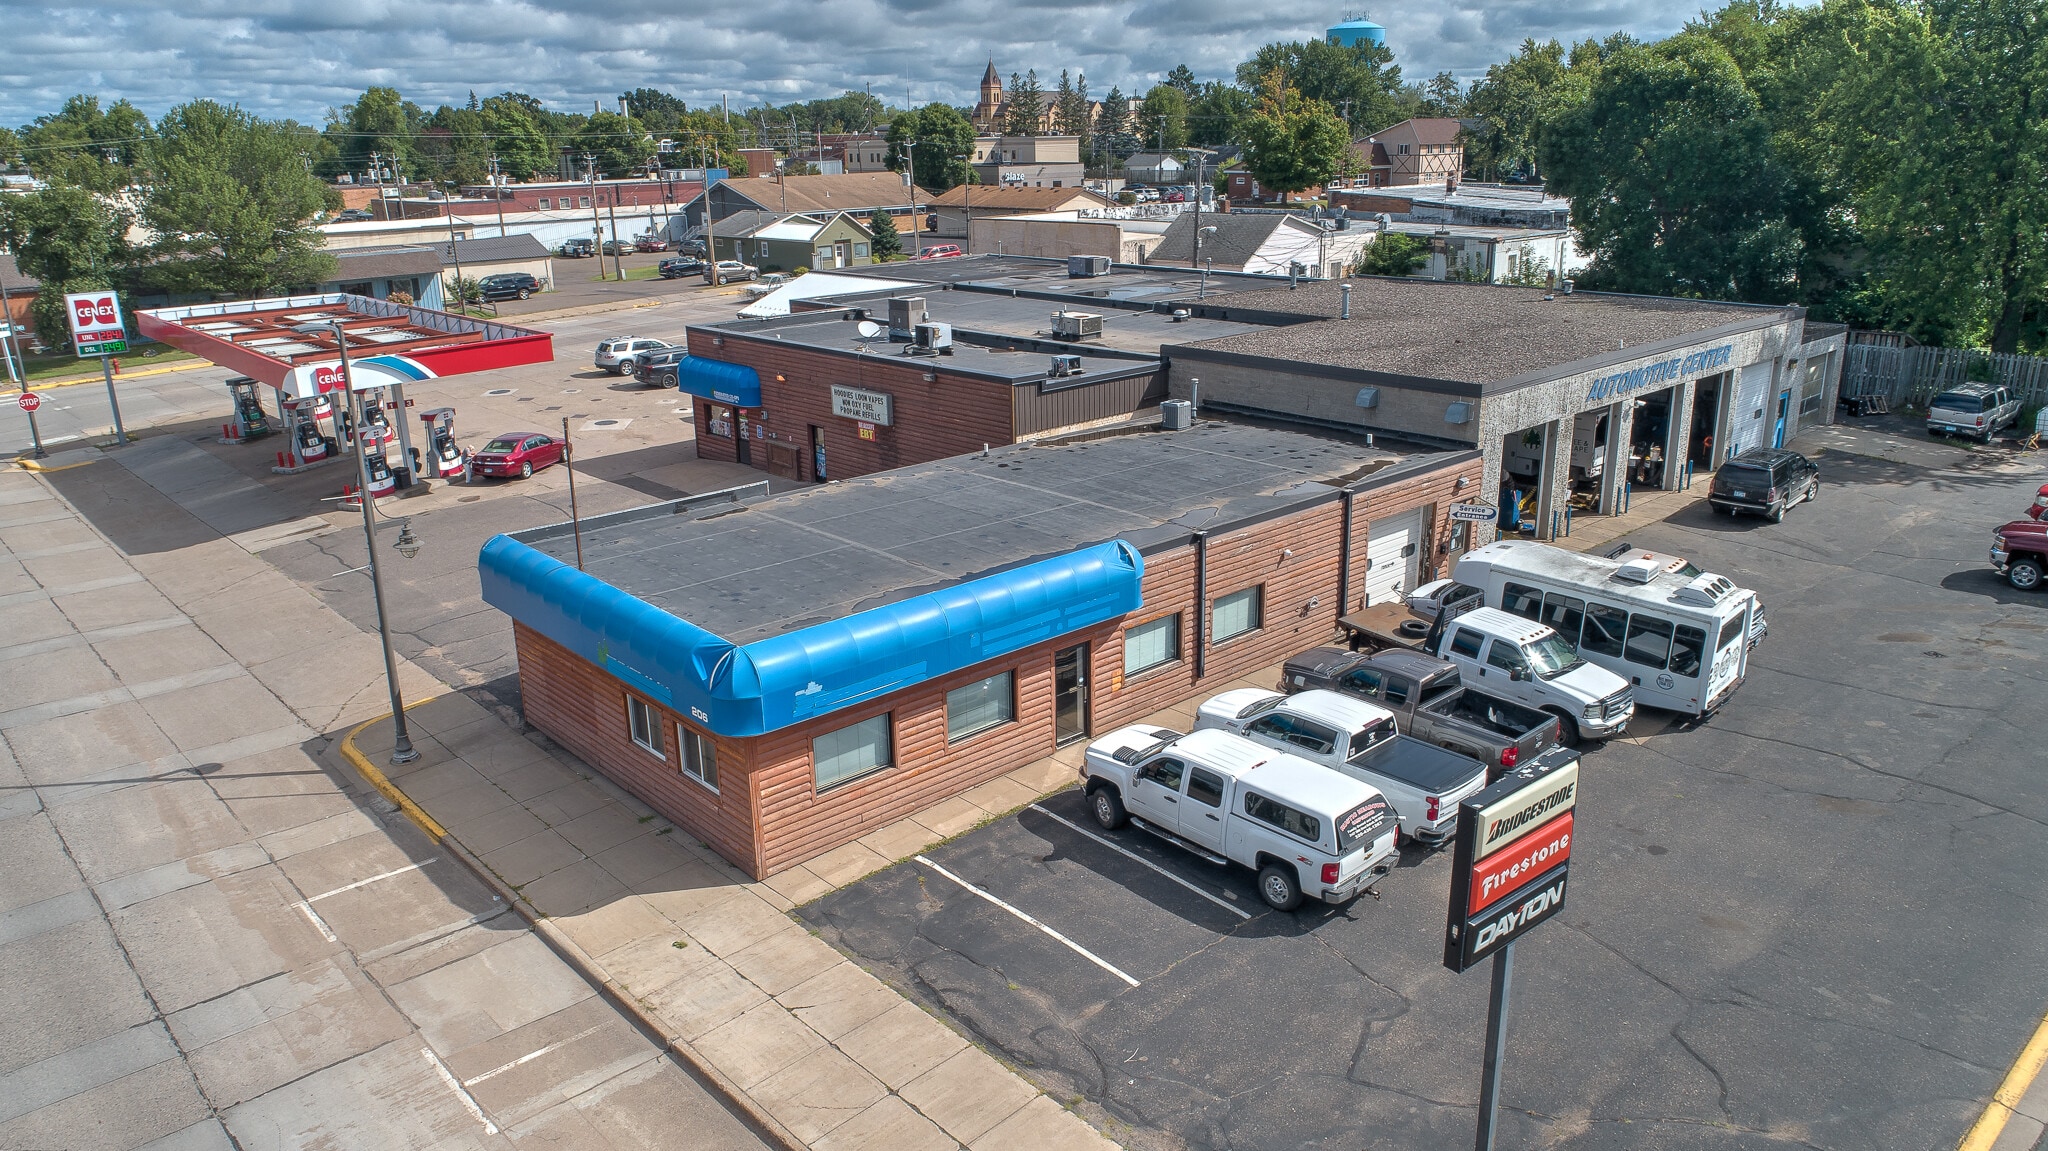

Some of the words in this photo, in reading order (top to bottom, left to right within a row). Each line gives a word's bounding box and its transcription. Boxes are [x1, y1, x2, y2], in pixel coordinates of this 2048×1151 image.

[77, 306, 114, 317] CENEX
[319, 372, 346, 384] CENE
[1585, 358, 1681, 402] AUTOMOTIVE
[1681, 344, 1732, 376] CENTER
[20, 398, 39, 407] STOP
[834, 388, 853, 399] HOODIES
[868, 396, 884, 405] VAPES
[852, 401, 861, 409] OXY
[862, 403, 874, 411] FUEL
[840, 406, 861, 417] PROPANE
[862, 412, 880, 420] REFILLS
[860, 429, 873, 440] EBT
[1459, 505, 1486, 513] Service
[1457, 512, 1488, 520] Entrance
[691, 706, 708, 723] 206
[1486, 781, 1575, 845] BRIDGESTONE
[1481, 833, 1569, 900] Firestone
[1473, 881, 1565, 954] DAYTON
